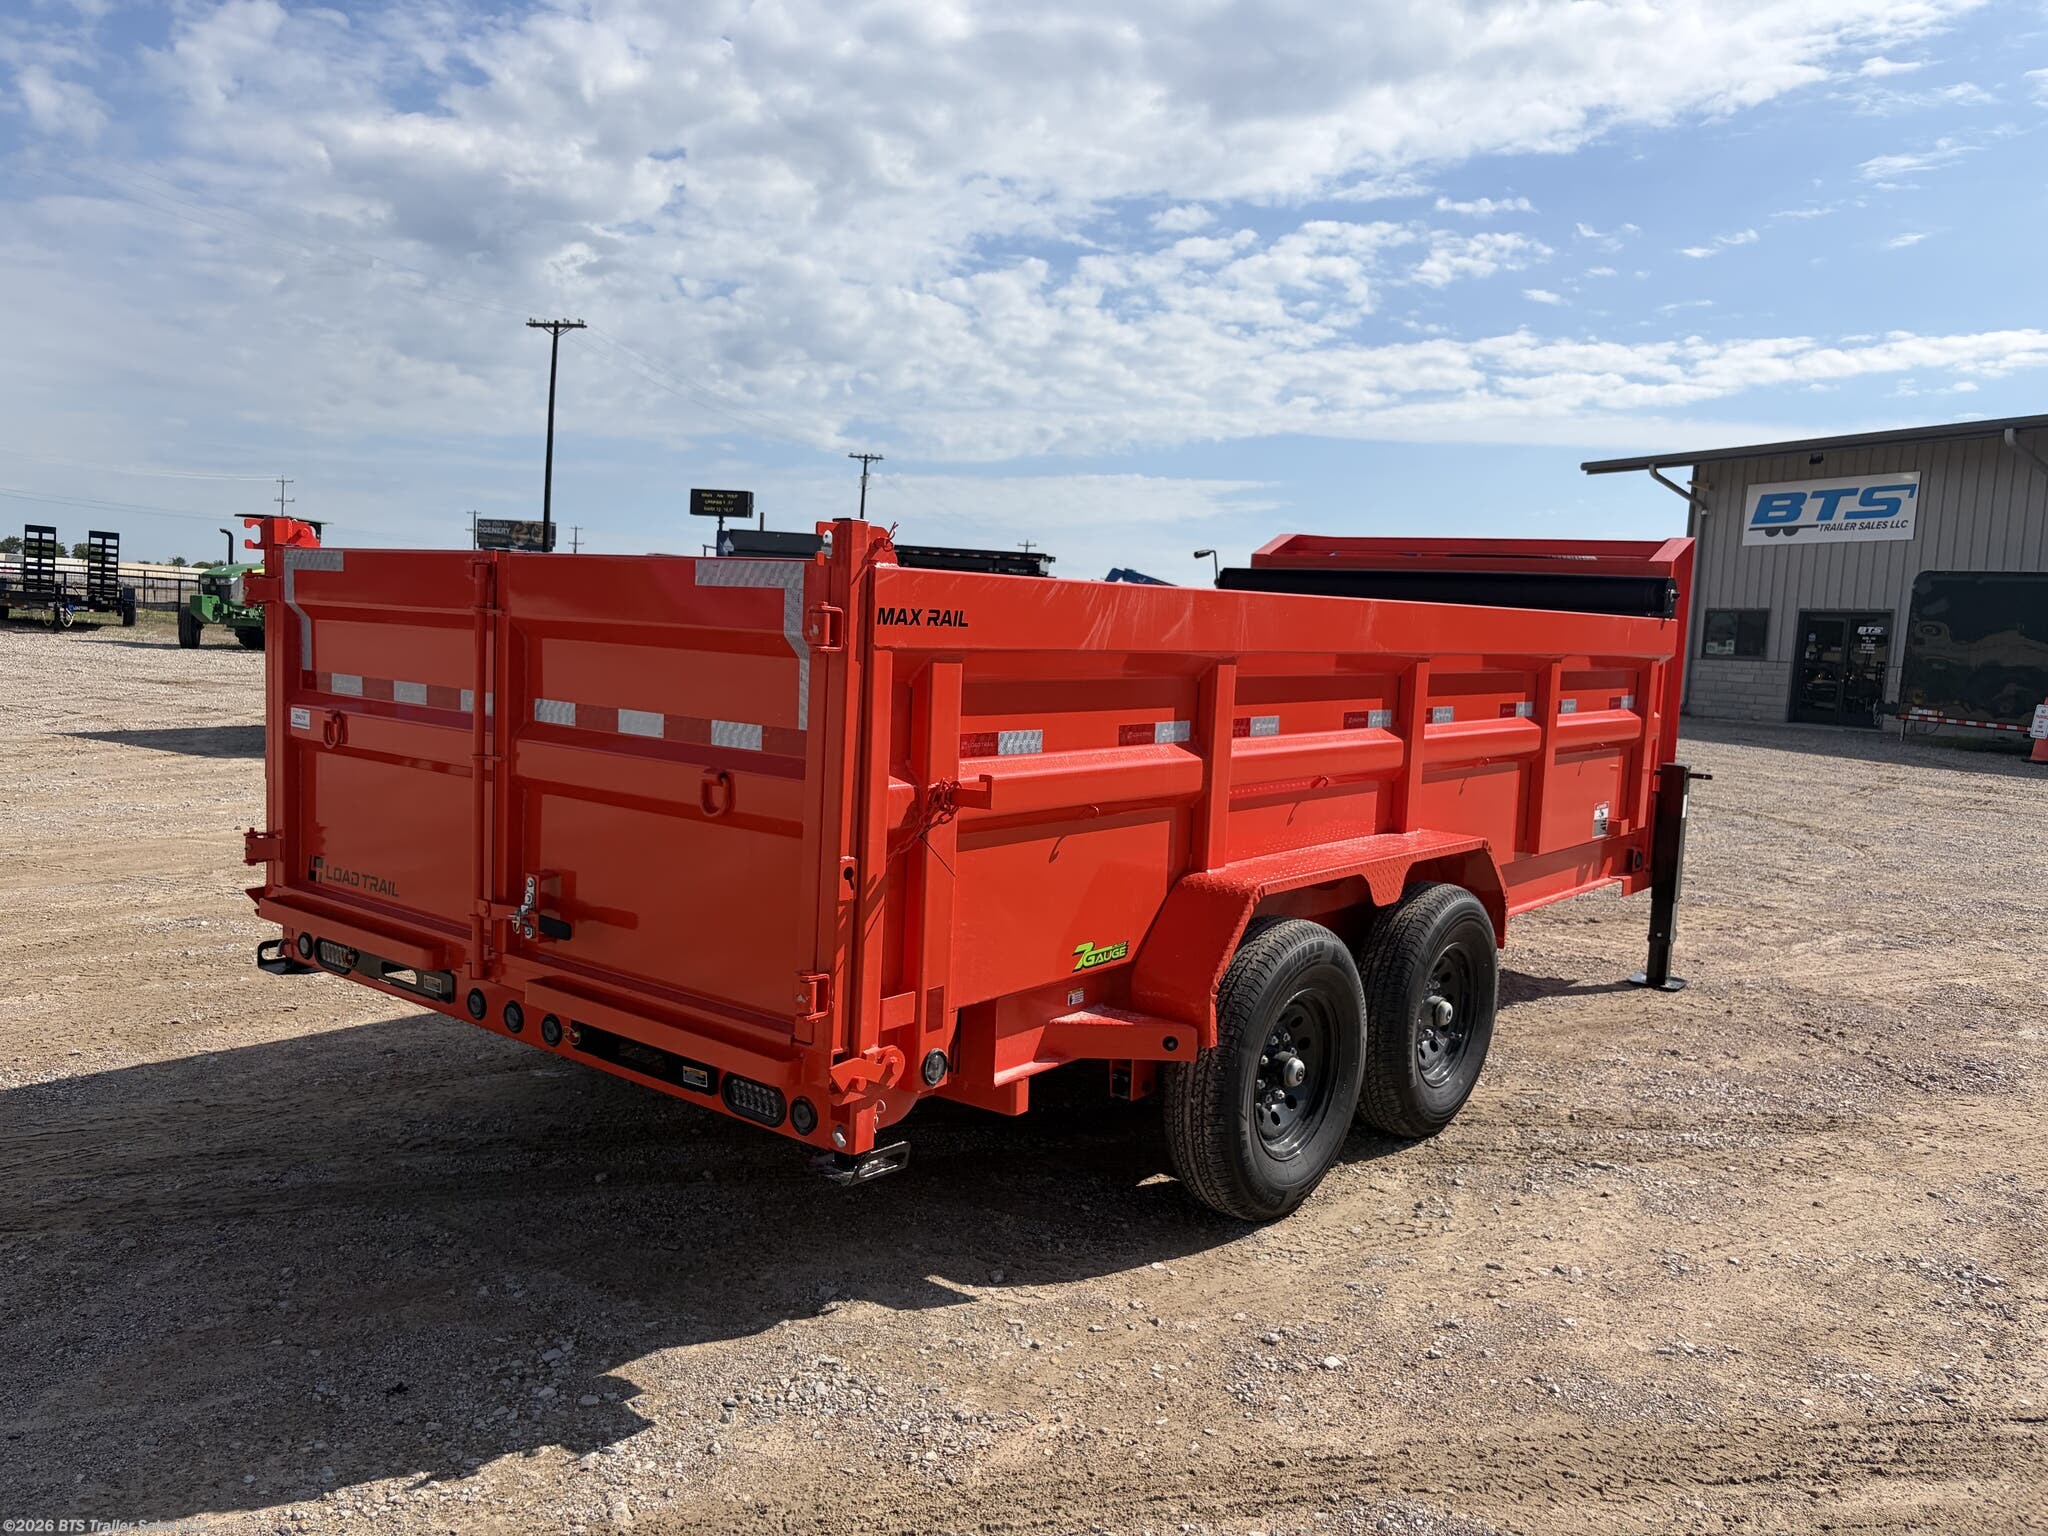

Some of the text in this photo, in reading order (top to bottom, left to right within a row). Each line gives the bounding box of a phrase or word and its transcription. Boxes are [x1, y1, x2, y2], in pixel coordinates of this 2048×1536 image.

[1750, 483, 1918, 525] BTS
[1819, 520, 1909, 533] TRAILER SALES LLC
[877, 607, 969, 627] MAX RAIL
[1857, 626, 1884, 634] BTS
